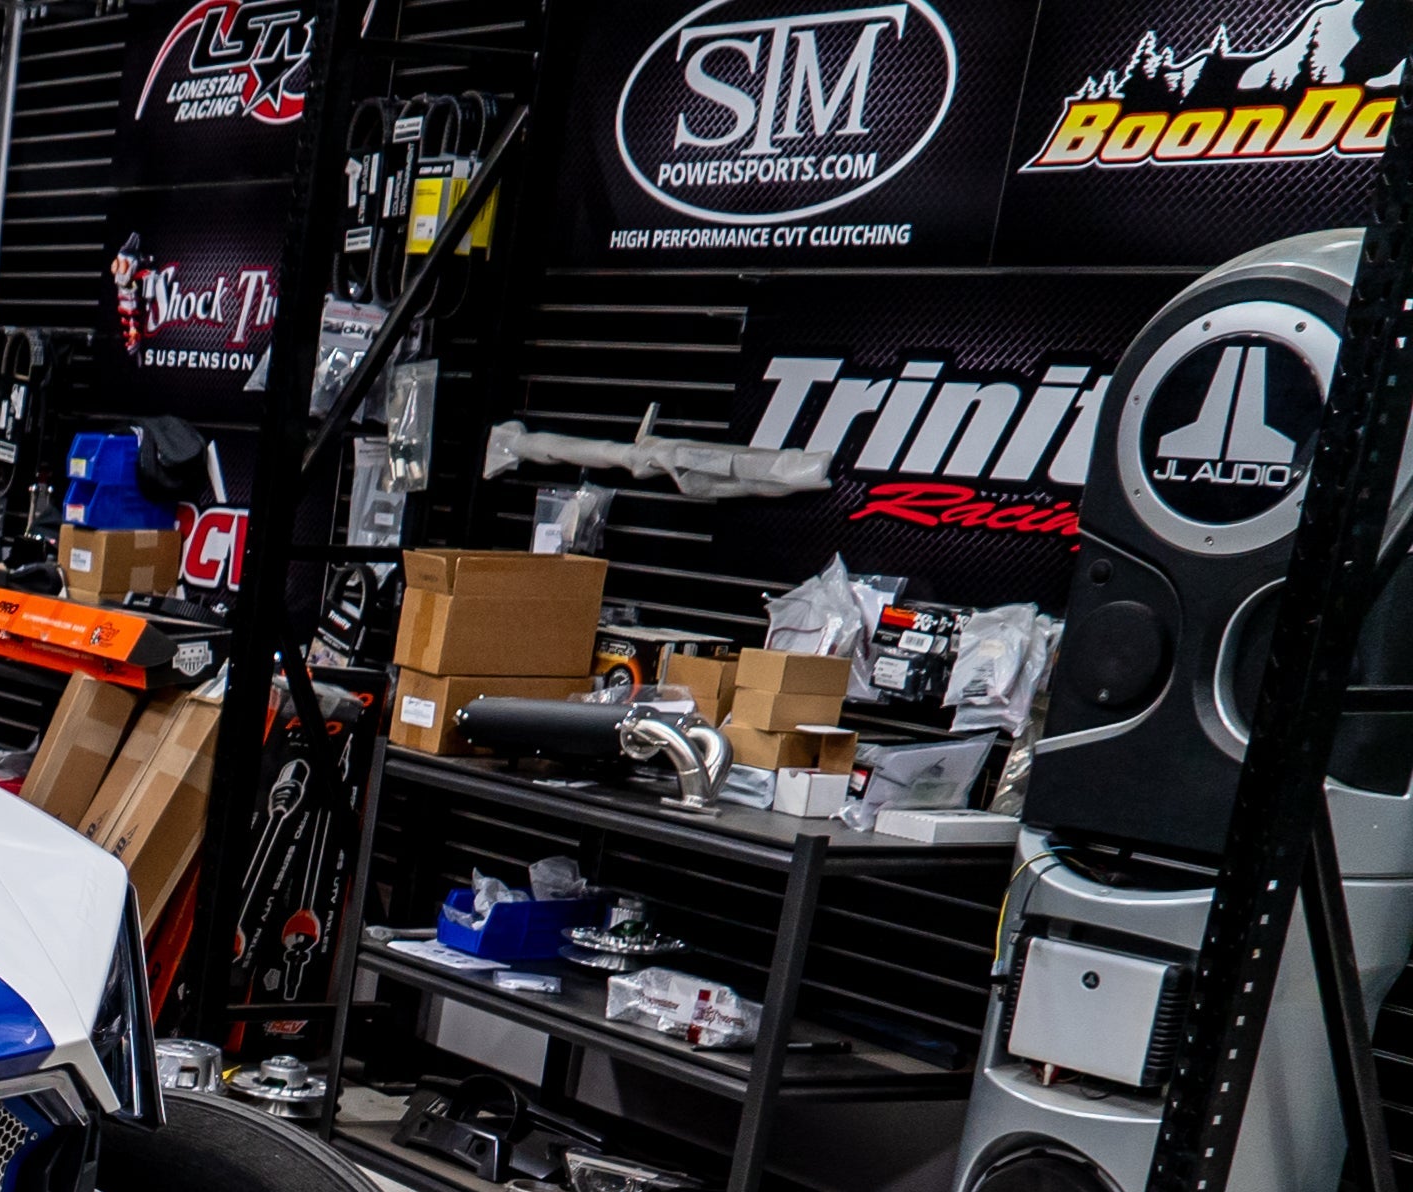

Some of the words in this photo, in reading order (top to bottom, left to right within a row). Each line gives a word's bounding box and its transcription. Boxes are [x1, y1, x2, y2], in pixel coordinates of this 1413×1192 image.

[166, 73, 248, 103] LONESTAR
[673, 3, 909, 156] STM
[174, 95, 239, 122] RACING
[657, 153, 877, 187] POWERSPORTS.COM
[610, 230, 649, 249] HIGH
[652, 228, 771, 249] PERFORMANCE
[773, 227, 808, 248] CVT
[809, 224, 912, 246] CLUTCHING
[146, 265, 228, 333] Shock
[231, 269, 279, 343] Th
[144, 349, 254, 370] SUSPENSION
[1153, 459, 1187, 480] JL
[1191, 461, 1291, 487] AUDIO
[849, 482, 1081, 537] Racin
